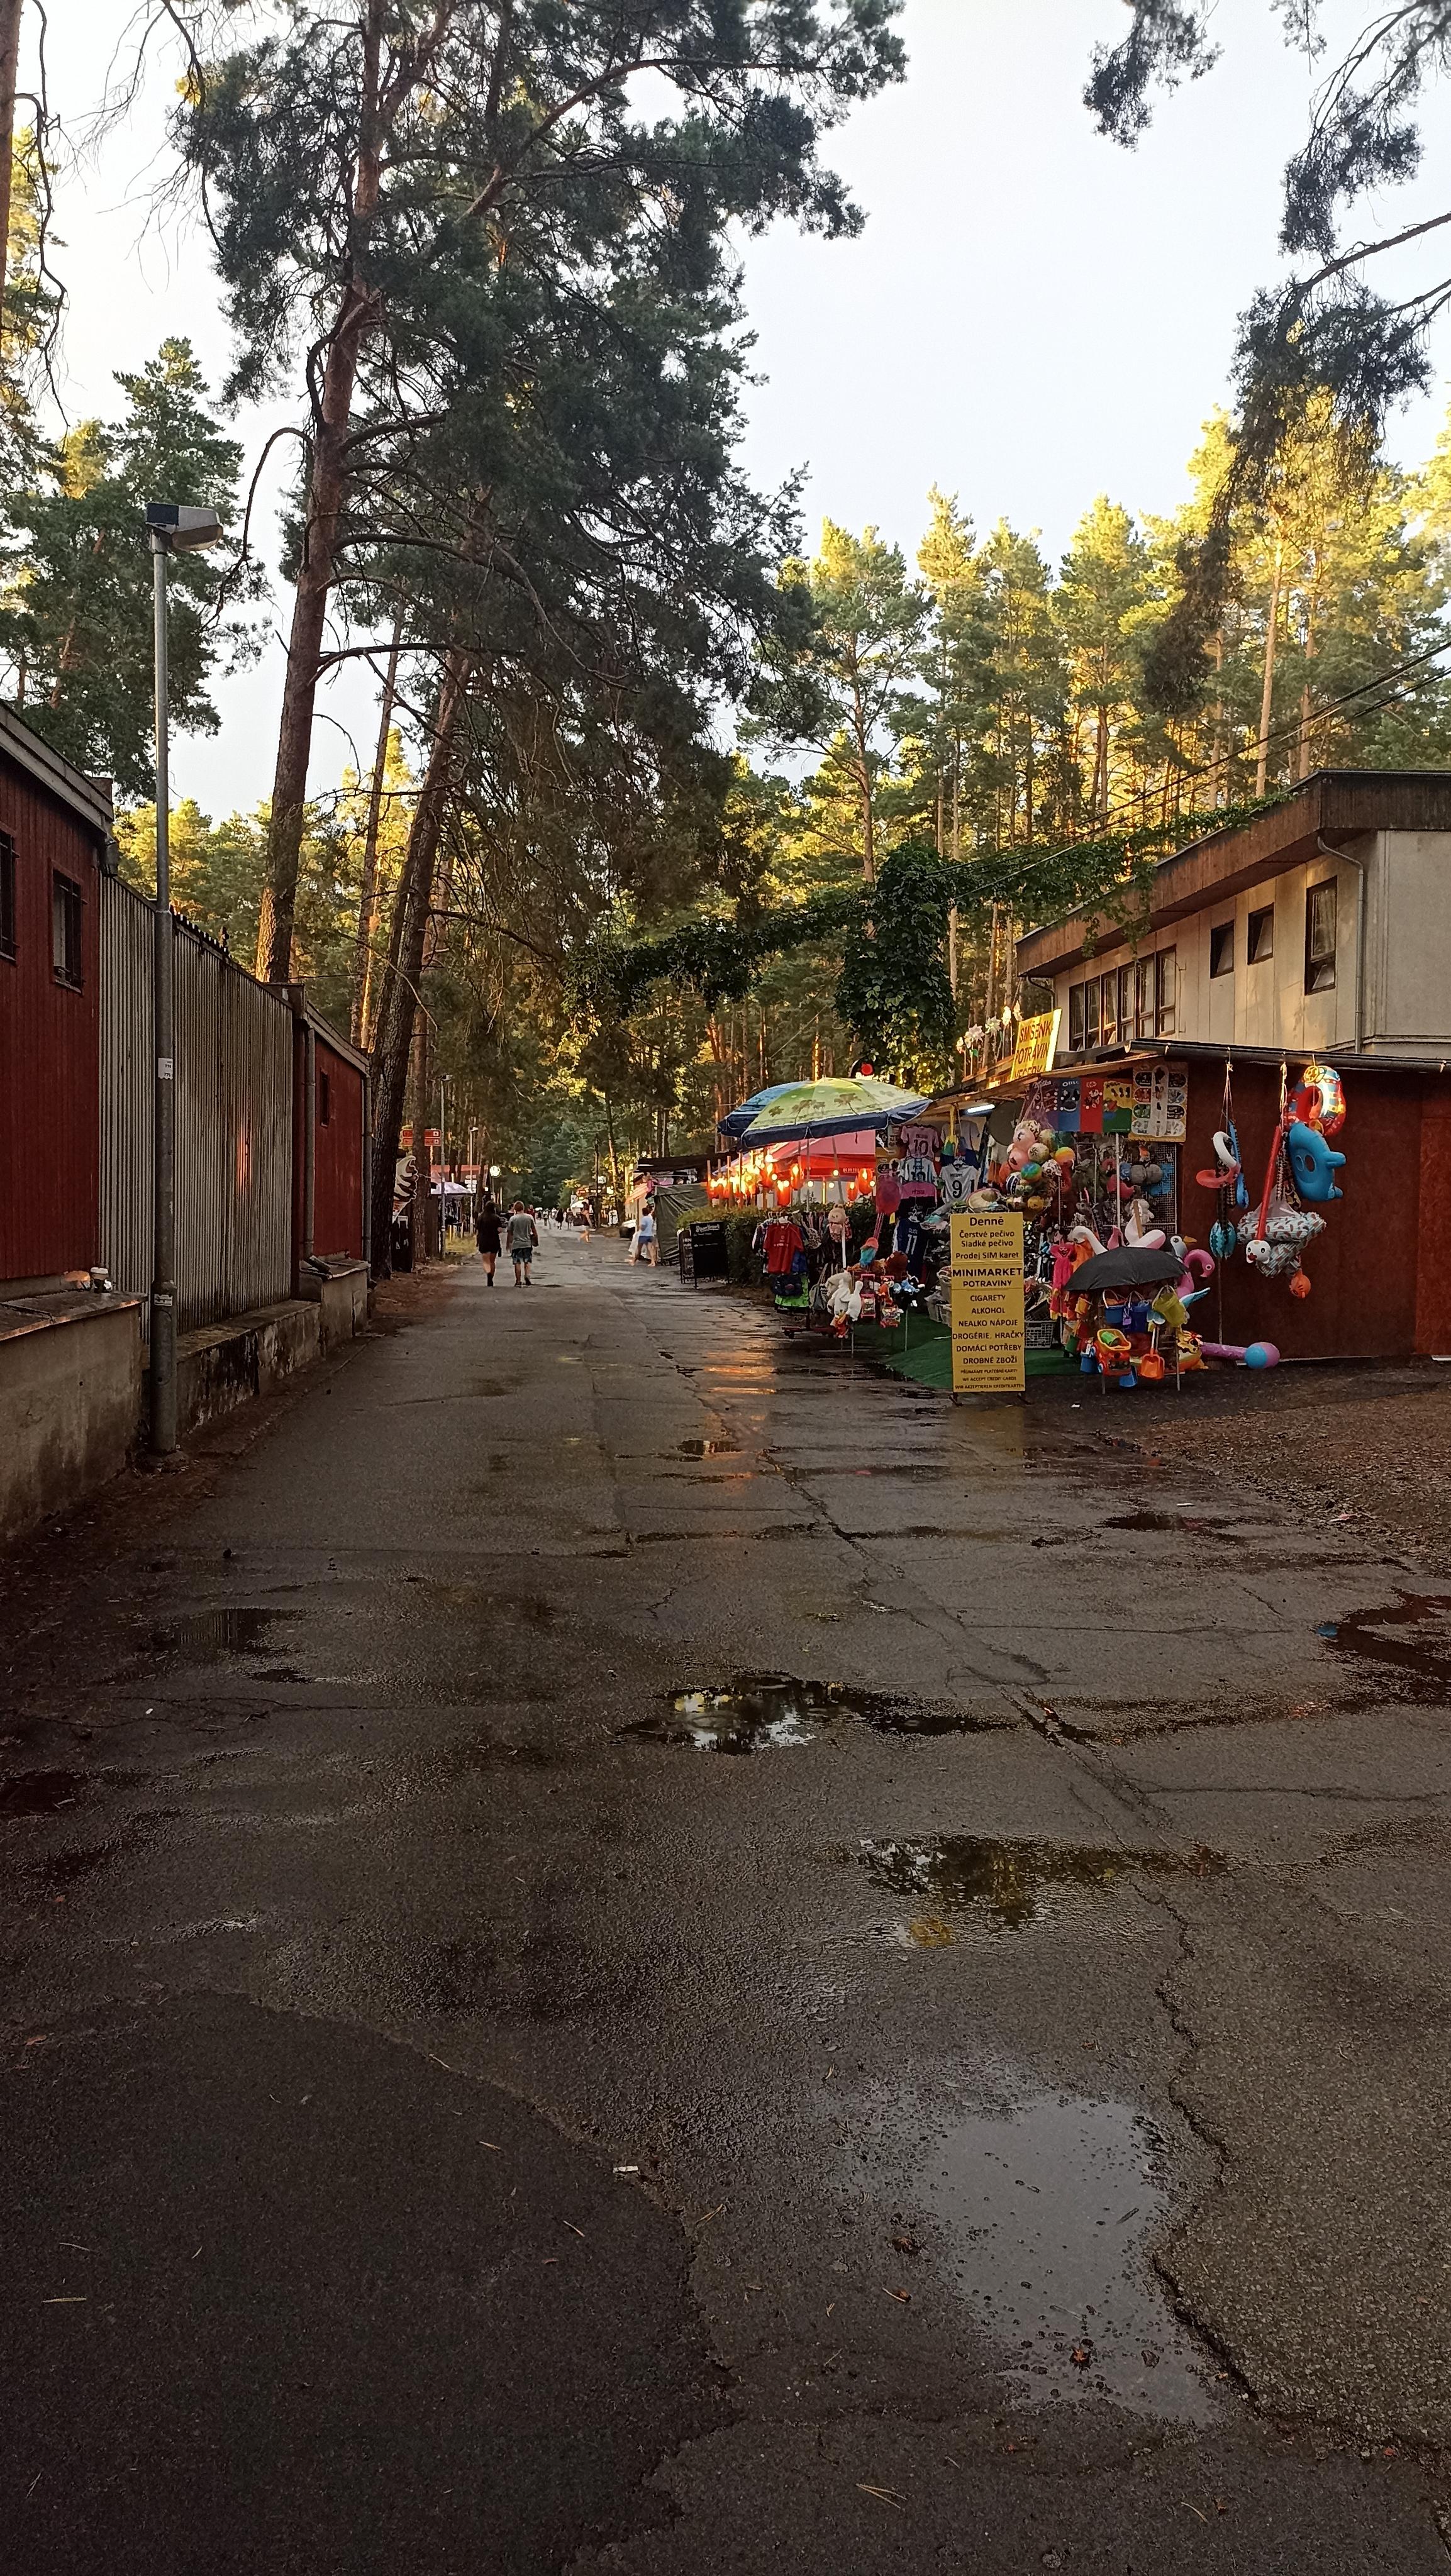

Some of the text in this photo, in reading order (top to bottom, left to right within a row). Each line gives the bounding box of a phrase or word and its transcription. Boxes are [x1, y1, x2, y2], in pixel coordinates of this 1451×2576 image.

[914, 1140, 928, 1156] 10
[952, 1180, 962, 1199] 9
[970, 1216, 1004, 1226] Denně
[990, 1230, 1015, 1238] pečivo
[906, 1234, 917, 1255] 11
[988, 1240, 1013, 1248] pečivo
[952, 1268, 1023, 1277] MINIMARKET
[995, 1330, 1024, 1338] HRAČKY
[996, 1355, 1017, 1363] ZBOŽÍ
